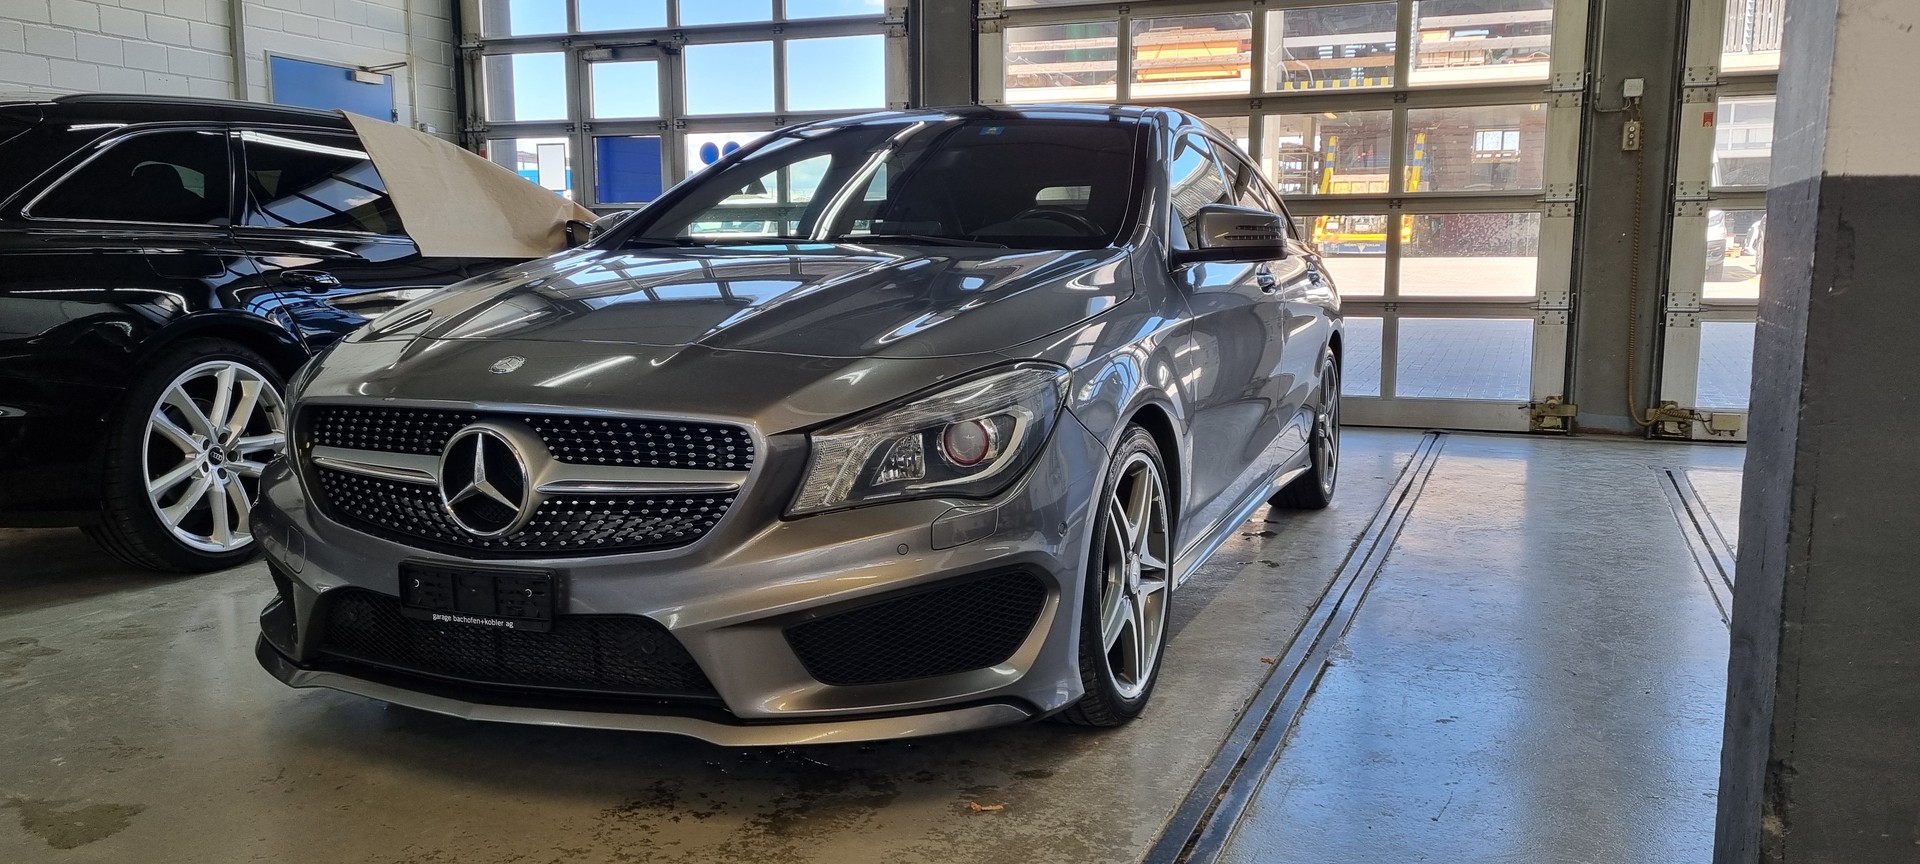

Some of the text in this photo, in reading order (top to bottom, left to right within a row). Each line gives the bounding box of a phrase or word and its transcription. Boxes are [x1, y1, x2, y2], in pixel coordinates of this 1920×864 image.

[432, 613, 514, 629] garage bachofen+kobler ag
